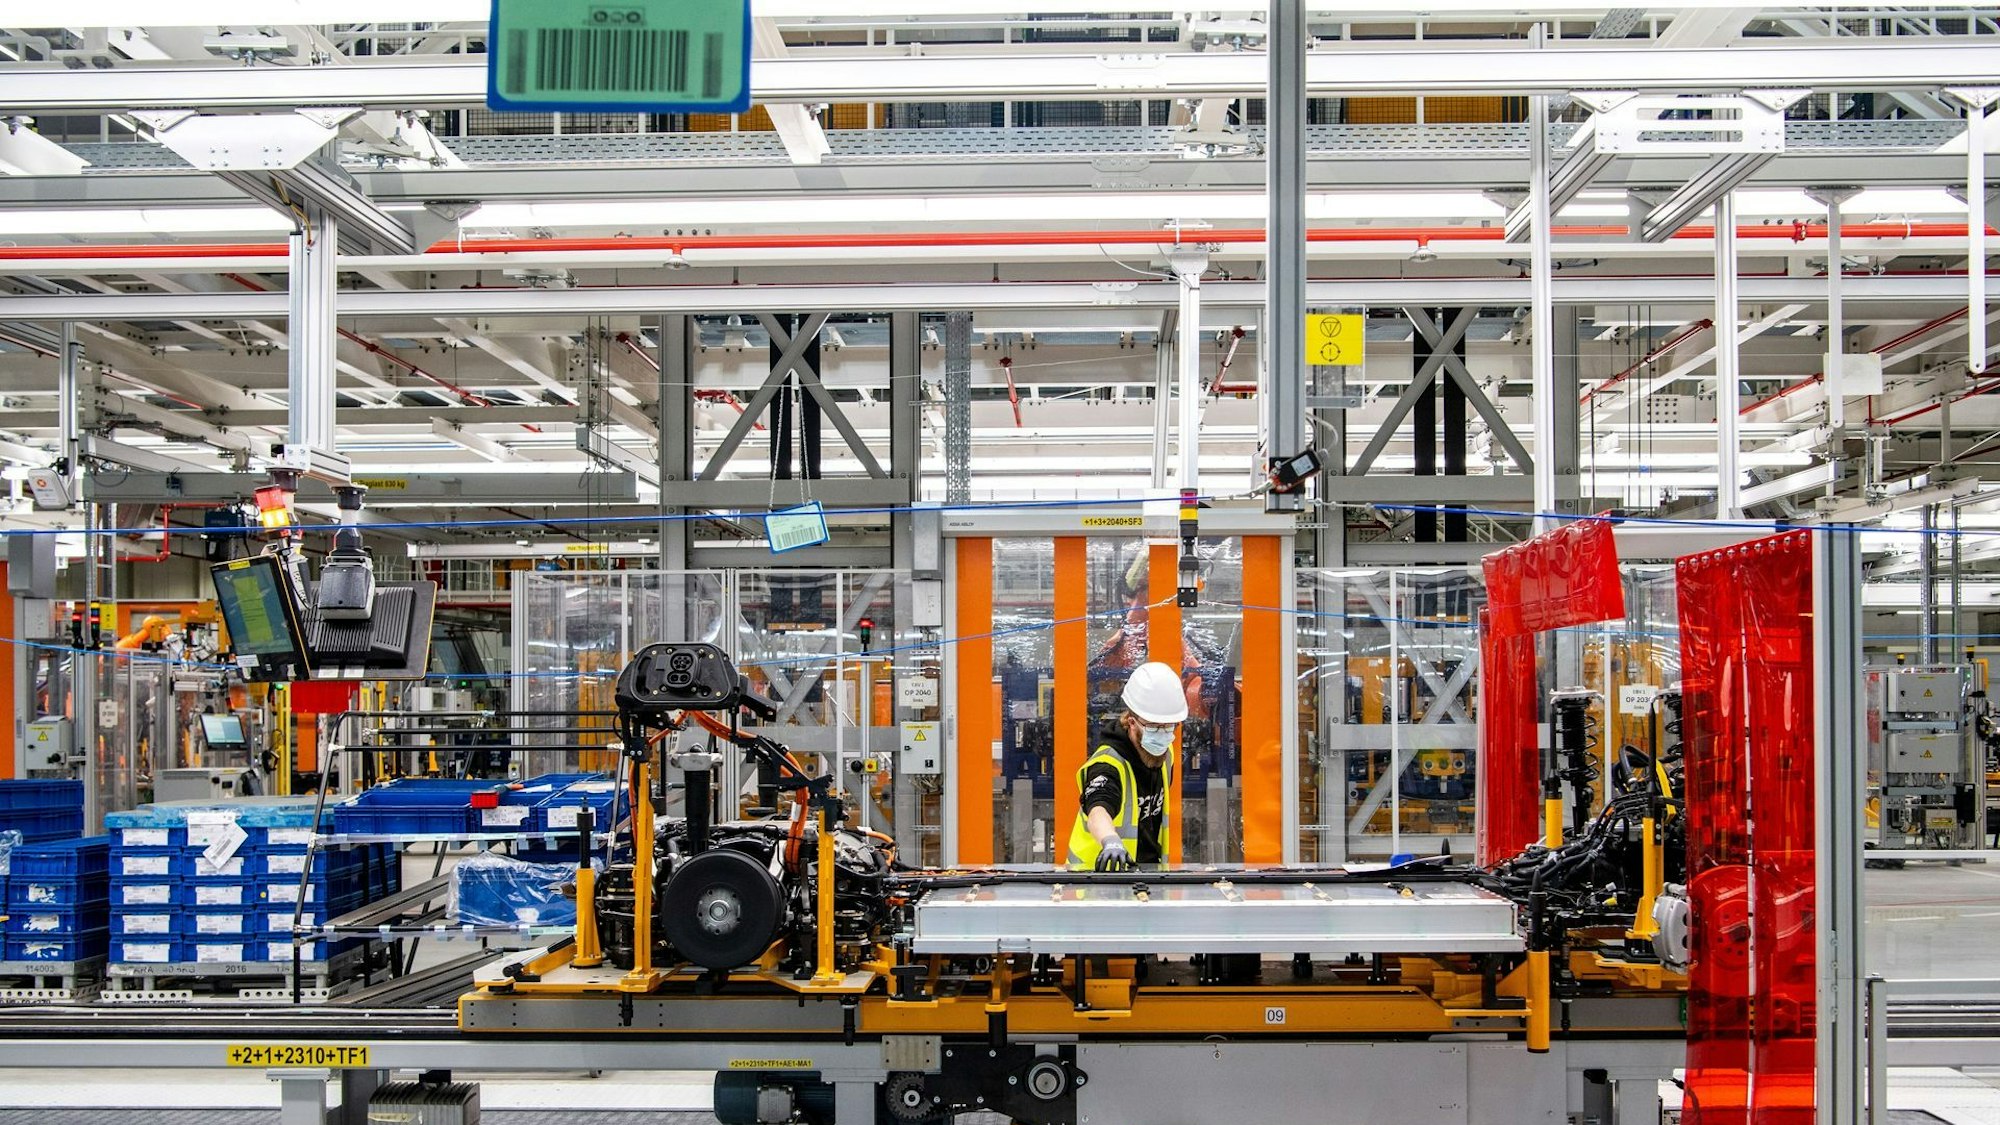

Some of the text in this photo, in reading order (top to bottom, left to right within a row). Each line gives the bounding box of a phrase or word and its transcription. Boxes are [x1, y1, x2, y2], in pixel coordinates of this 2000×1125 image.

[1084, 518, 1142, 526] +1+3+2040+SF3
[26, 965, 55, 973] 114003
[225, 965, 247, 973] 2016
[1268, 1009, 1284, 1021] 09
[232, 1047, 367, 1064] +2+1+2310+TF1
